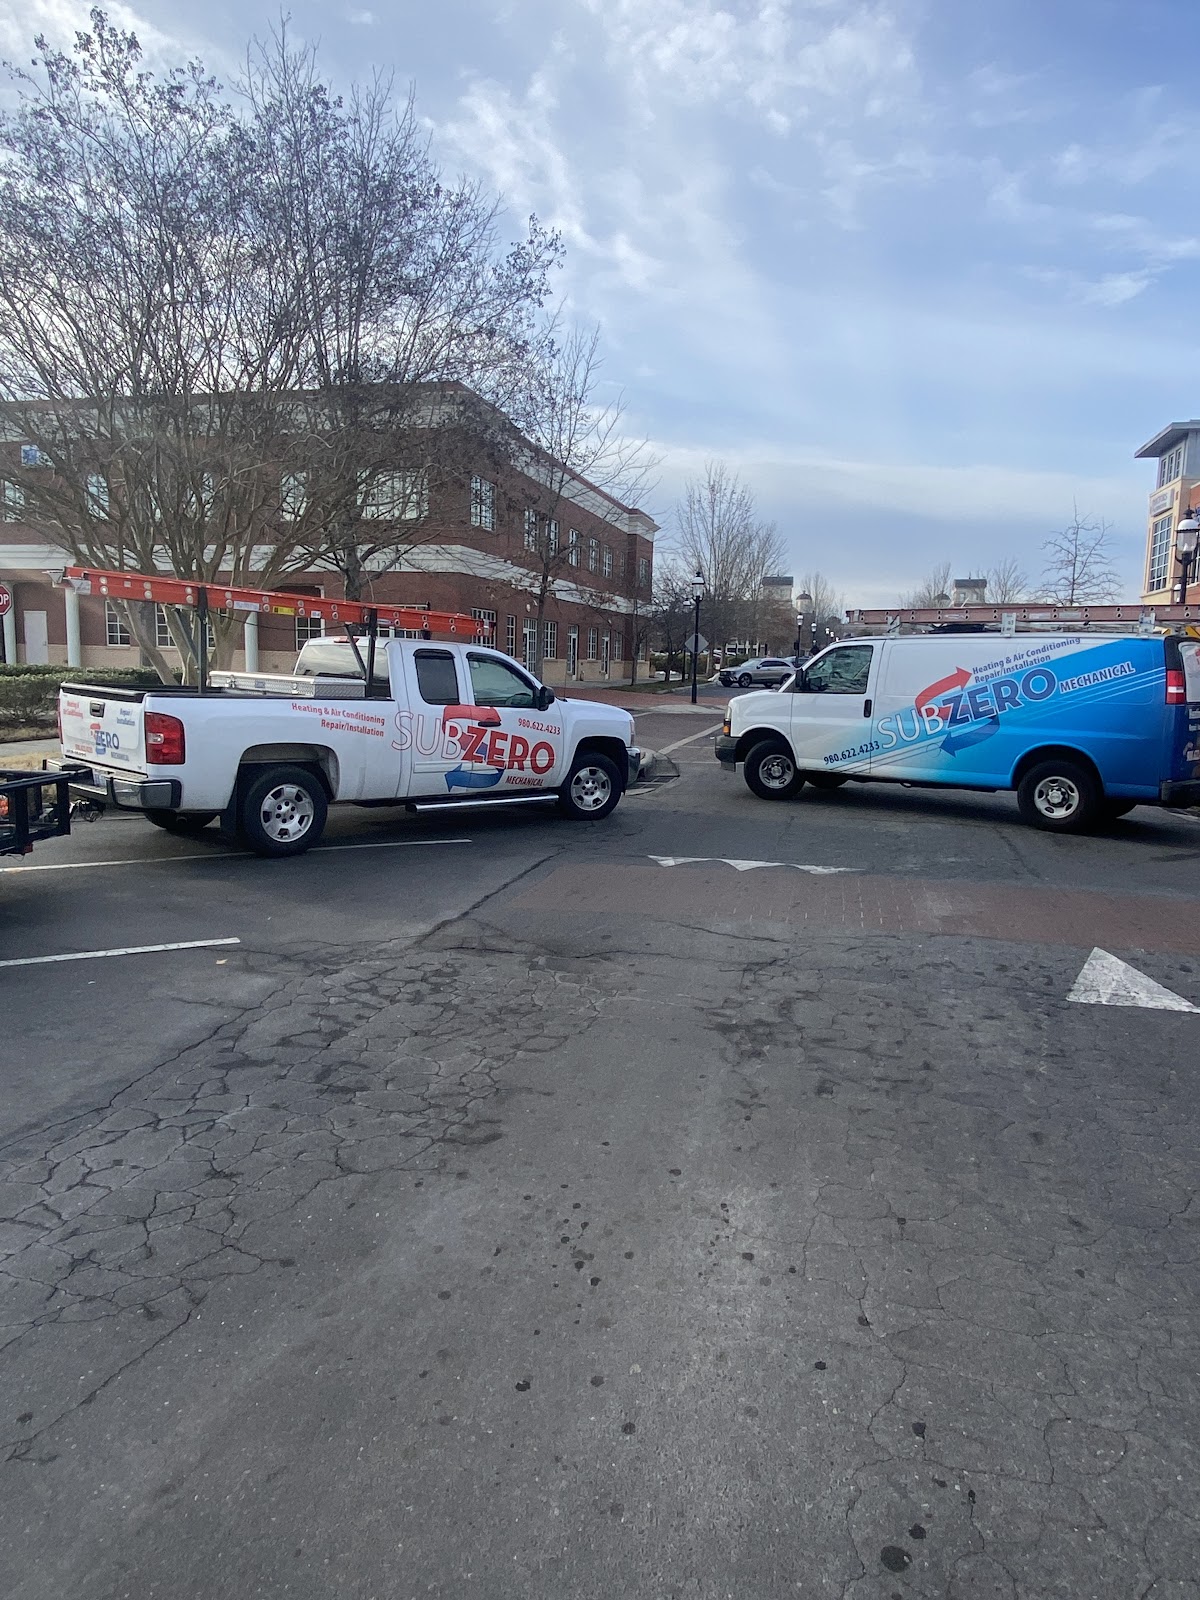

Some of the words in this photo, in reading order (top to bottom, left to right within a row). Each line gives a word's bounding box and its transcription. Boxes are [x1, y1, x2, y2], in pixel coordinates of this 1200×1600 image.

[972, 659, 1005, 675] Heating
[1005, 656, 1012, 664] &
[1013, 653, 1024, 662] Air
[1026, 638, 1081, 658] Conditioning
[974, 654, 1051, 684] Repair/Installation
[1060, 661, 1135, 693] MECHANICAL
[291, 702, 322, 716] Heating
[323, 707, 330, 715] &
[331, 708, 341, 717] Air
[342, 710, 385, 726] Conditioning
[518, 717, 561, 735] 980.622.4233
[321, 719, 384, 737] Repair/Installation
[823, 740, 880, 766] 980.622.4233
[505, 775, 544, 786] MECHANICAL
